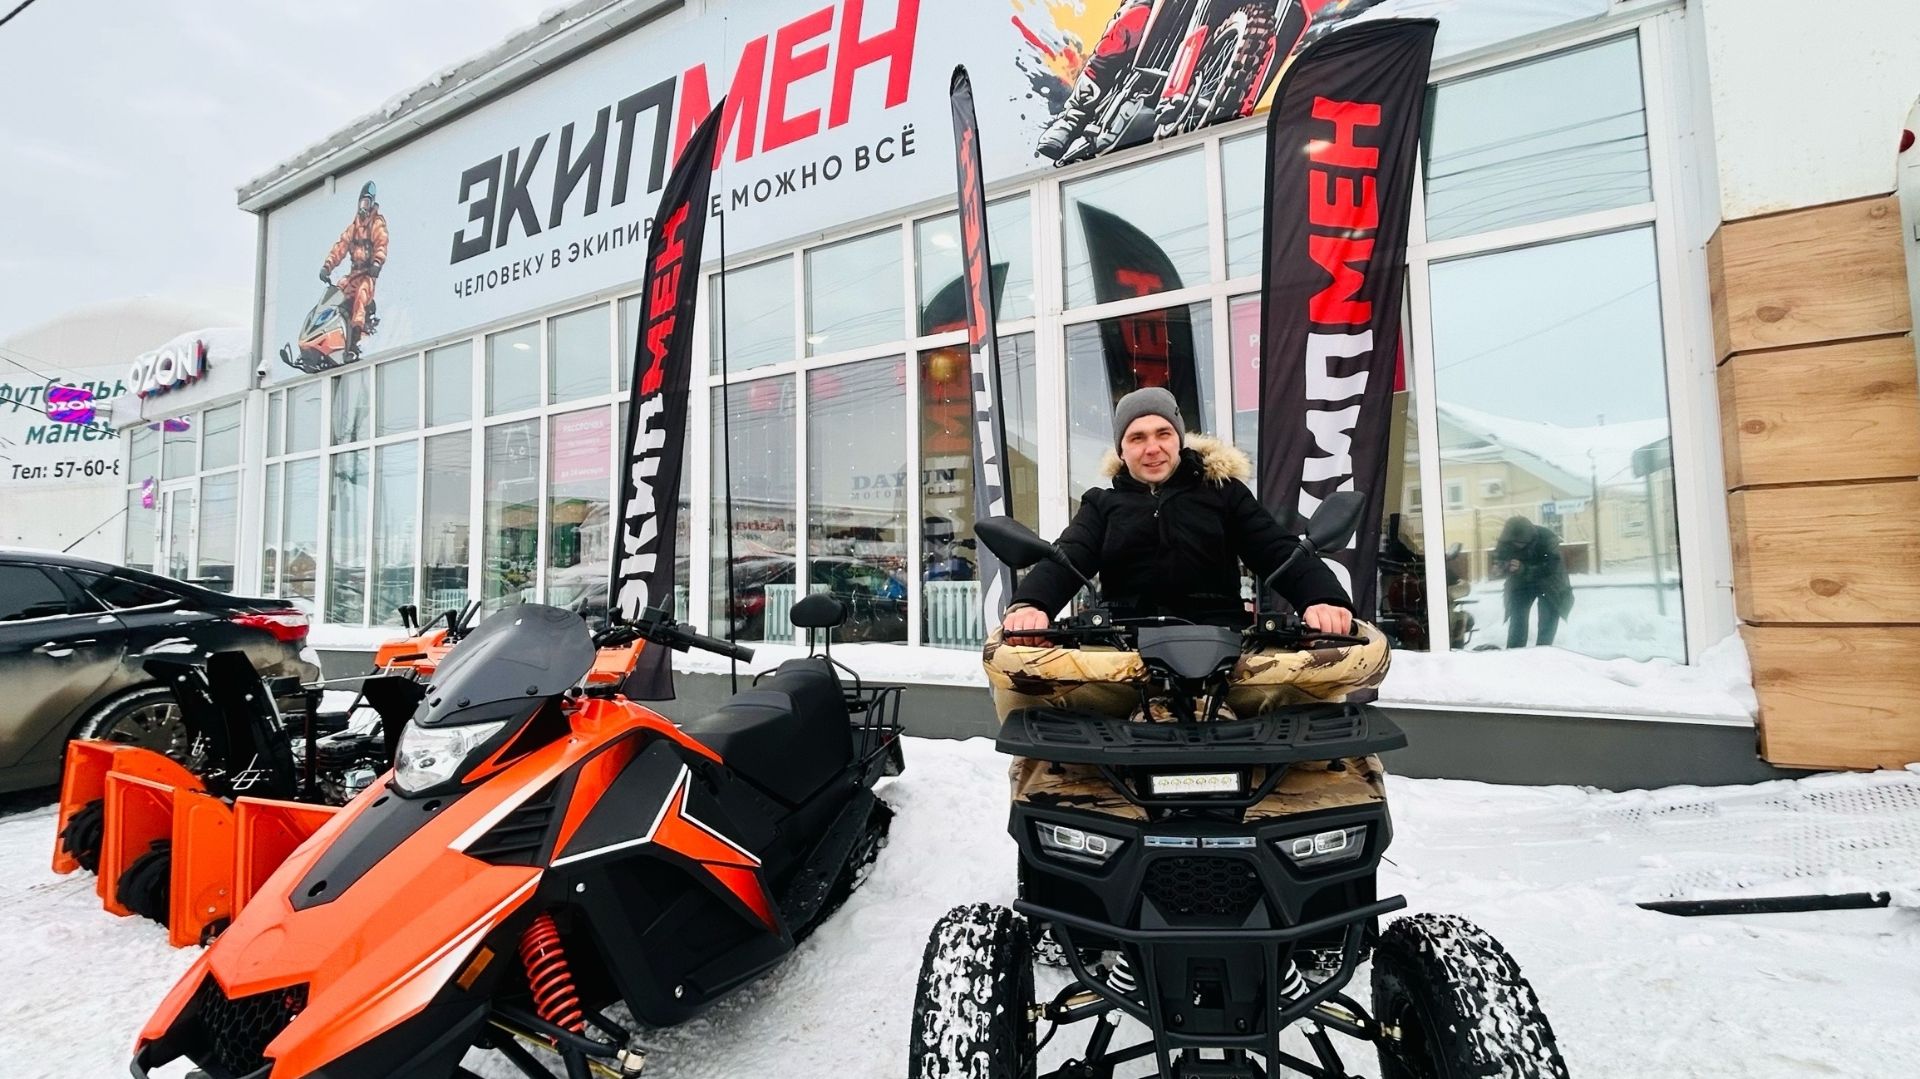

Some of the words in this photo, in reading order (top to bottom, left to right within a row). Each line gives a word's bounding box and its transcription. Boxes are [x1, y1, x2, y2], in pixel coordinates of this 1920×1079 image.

[450, 0, 920, 266] ЭКИПМЕН
[454, 253, 544, 298] ЧЕЛОВЕКУ
[551, 248, 561, 269] В
[568, 194, 722, 263] ЭКИПИРЕ
[732, 155, 842, 211] МОЖНО
[855, 123, 916, 172] ВСЁ
[129, 343, 202, 393] OZON
[1297, 96, 1382, 605] ИПМЕН
[12, 464, 47, 480] Тел:
[851, 485, 956, 500] MOTORCLE
